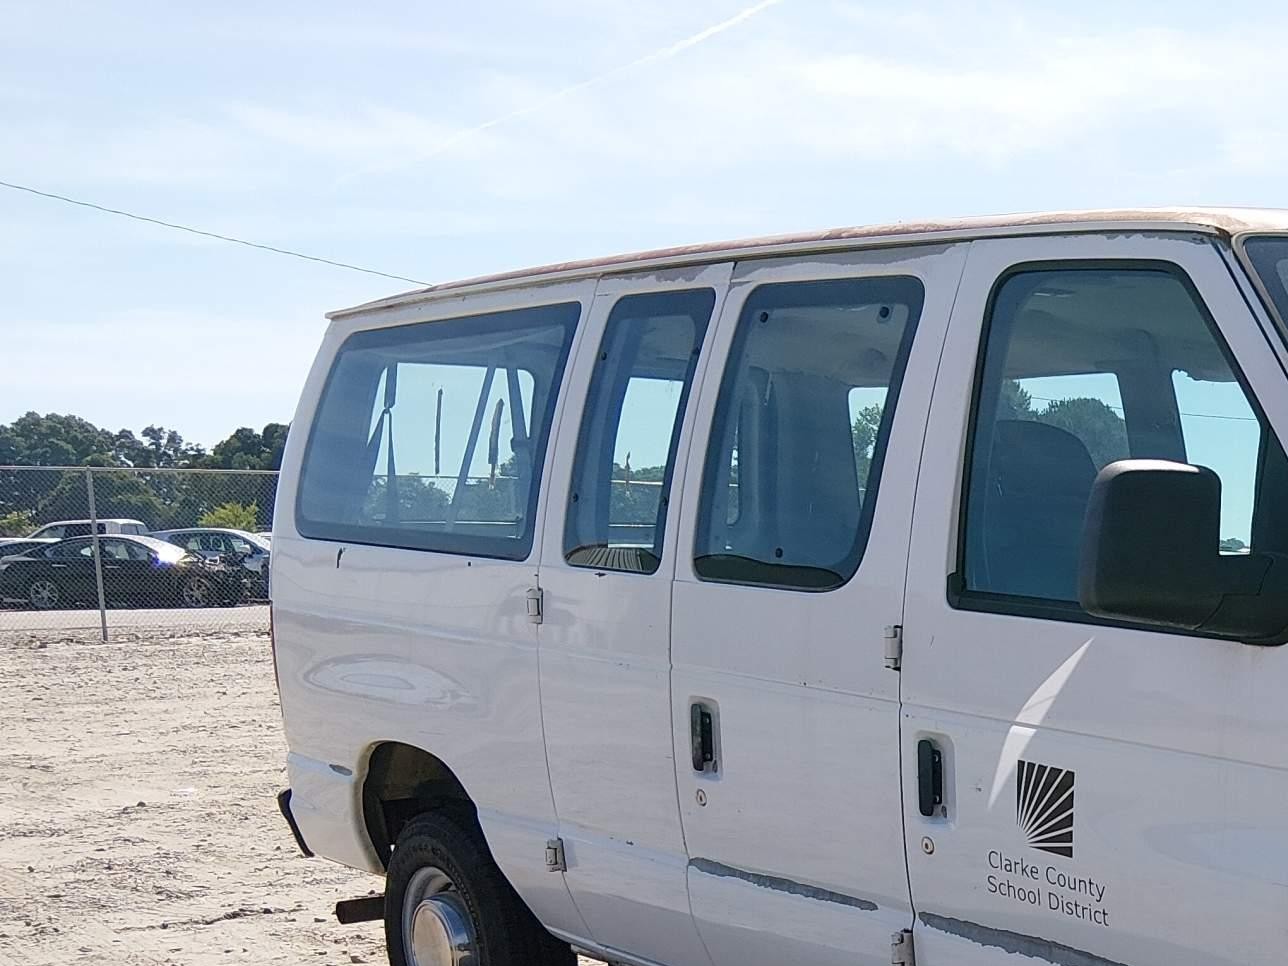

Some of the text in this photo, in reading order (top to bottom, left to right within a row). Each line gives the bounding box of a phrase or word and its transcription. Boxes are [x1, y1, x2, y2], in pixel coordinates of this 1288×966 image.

[987, 875, 1110, 926] School District
[988, 850, 1105, 902] Clarke County
